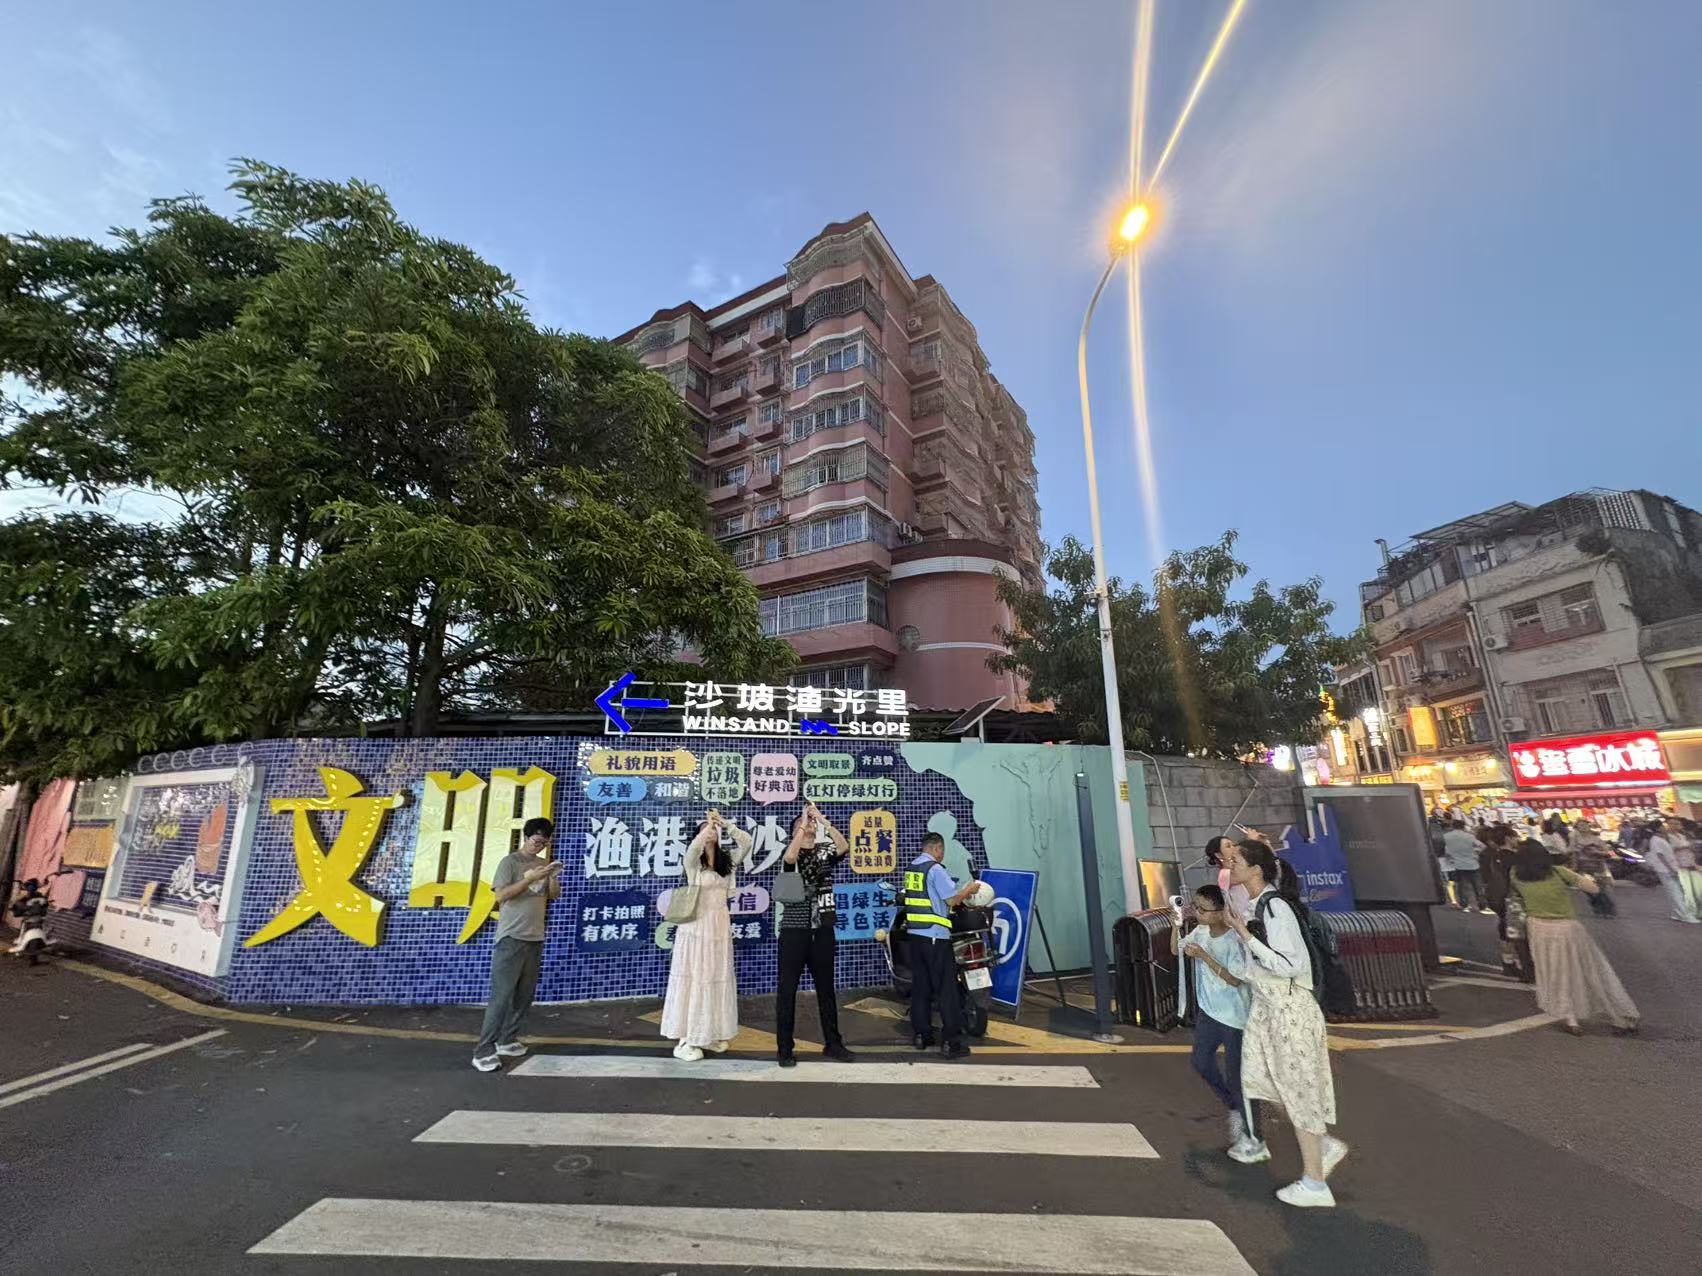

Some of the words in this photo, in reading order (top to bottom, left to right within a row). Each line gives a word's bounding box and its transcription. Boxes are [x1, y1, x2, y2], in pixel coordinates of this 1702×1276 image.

[682, 715, 790, 733] WINSAND
[849, 721, 911, 736] SLOPE
[606, 755, 676, 771] 礼貌用语
[752, 766, 797, 776] 尊老爱幼
[807, 759, 850, 770] 文明取景
[707, 766, 740, 785] 垃圾
[597, 782, 633, 798] 友善
[654, 782, 690, 797] 和谐
[706, 787, 739, 799] 不落地
[754, 779, 795, 793] 好典范
[806, 783, 896, 798] 红灯停绿灯行
[854, 829, 893, 854] 点餐
[243, 765, 558, 948] 文明
[1306, 870, 1343, 886] instax
[582, 905, 646, 921] 打卡拍照
[582, 923, 639, 942] 有秩序
